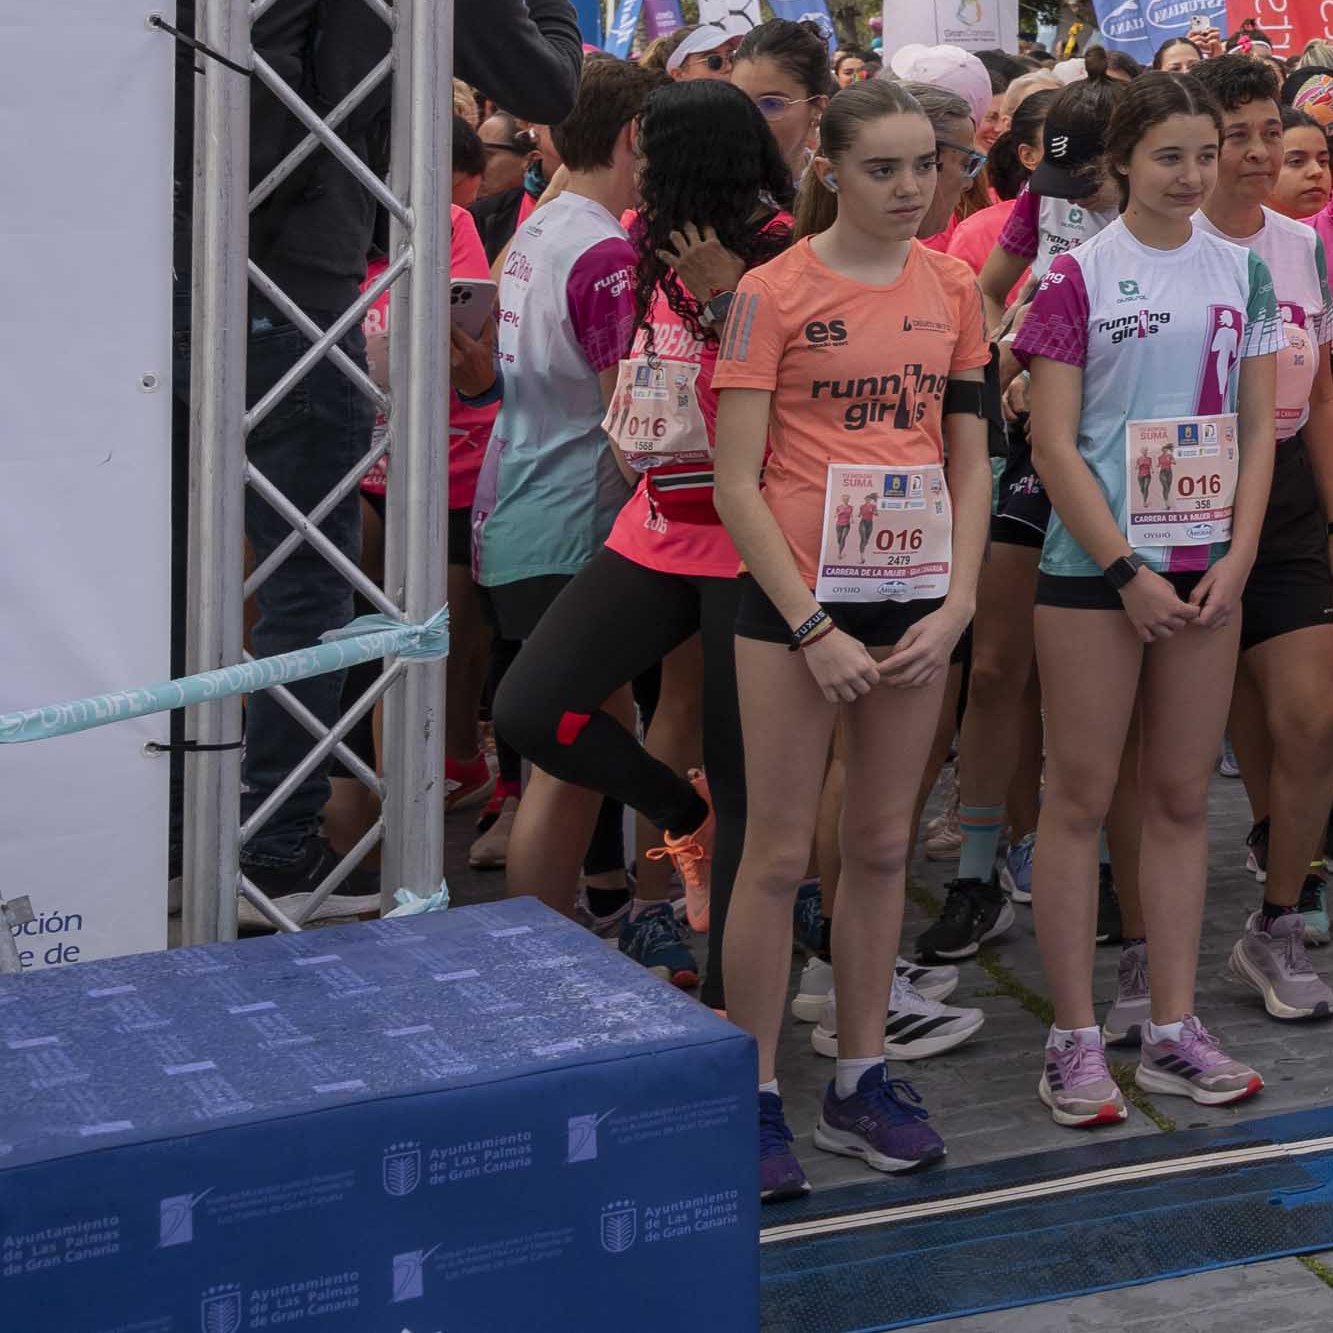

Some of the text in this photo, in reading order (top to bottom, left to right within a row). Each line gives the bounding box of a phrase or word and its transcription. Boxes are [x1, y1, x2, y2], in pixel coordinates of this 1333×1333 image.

[805, 320, 847, 342] es
[628, 416, 667, 438] 016
[1178, 474, 1221, 496] 016
[1135, 514, 1166, 522] CARRERA
[1168, 514, 1177, 522] DE
[876, 529, 922, 551] 016
[888, 555, 910, 565] 2479
[826, 567, 859, 576] CARRERA
[861, 568, 870, 576] DE
[44, 943, 80, 964] de
